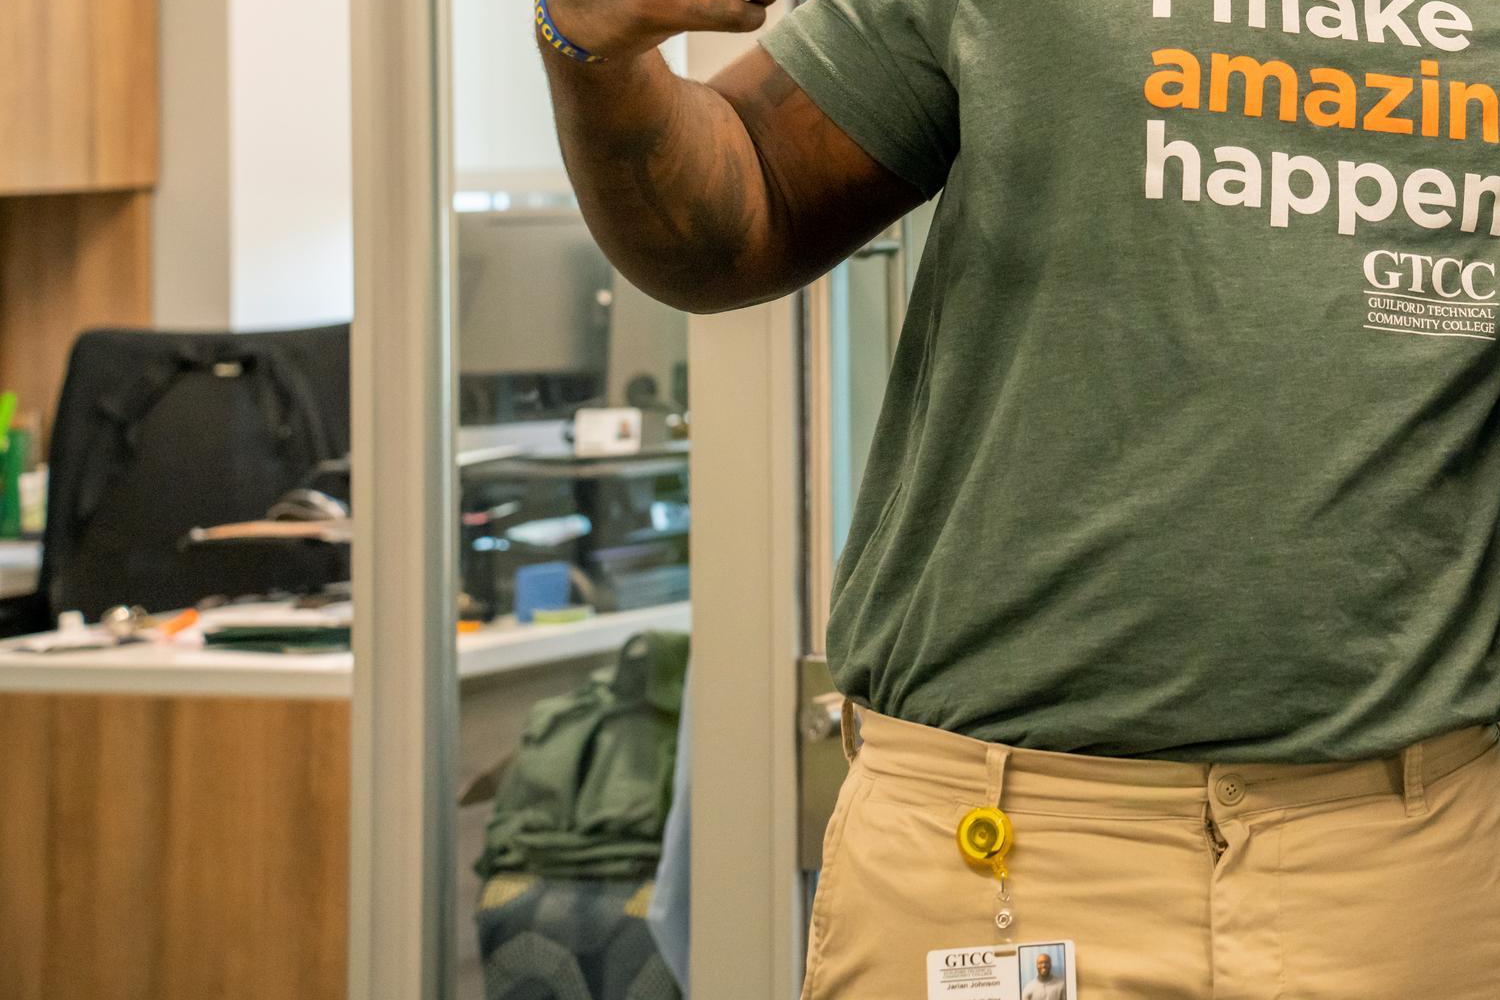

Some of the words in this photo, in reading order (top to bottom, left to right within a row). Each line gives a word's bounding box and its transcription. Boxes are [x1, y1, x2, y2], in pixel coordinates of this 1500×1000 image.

[1363, 249, 1496, 300] GTCC
[1368, 297, 1425, 314] GUILFORD
[1427, 304, 1496, 319] TECHNICAL
[1367, 311, 1440, 330] COMMUNITY
[1442, 320, 1496, 334] COLLEGE
[945, 951, 994, 967] GTCC
